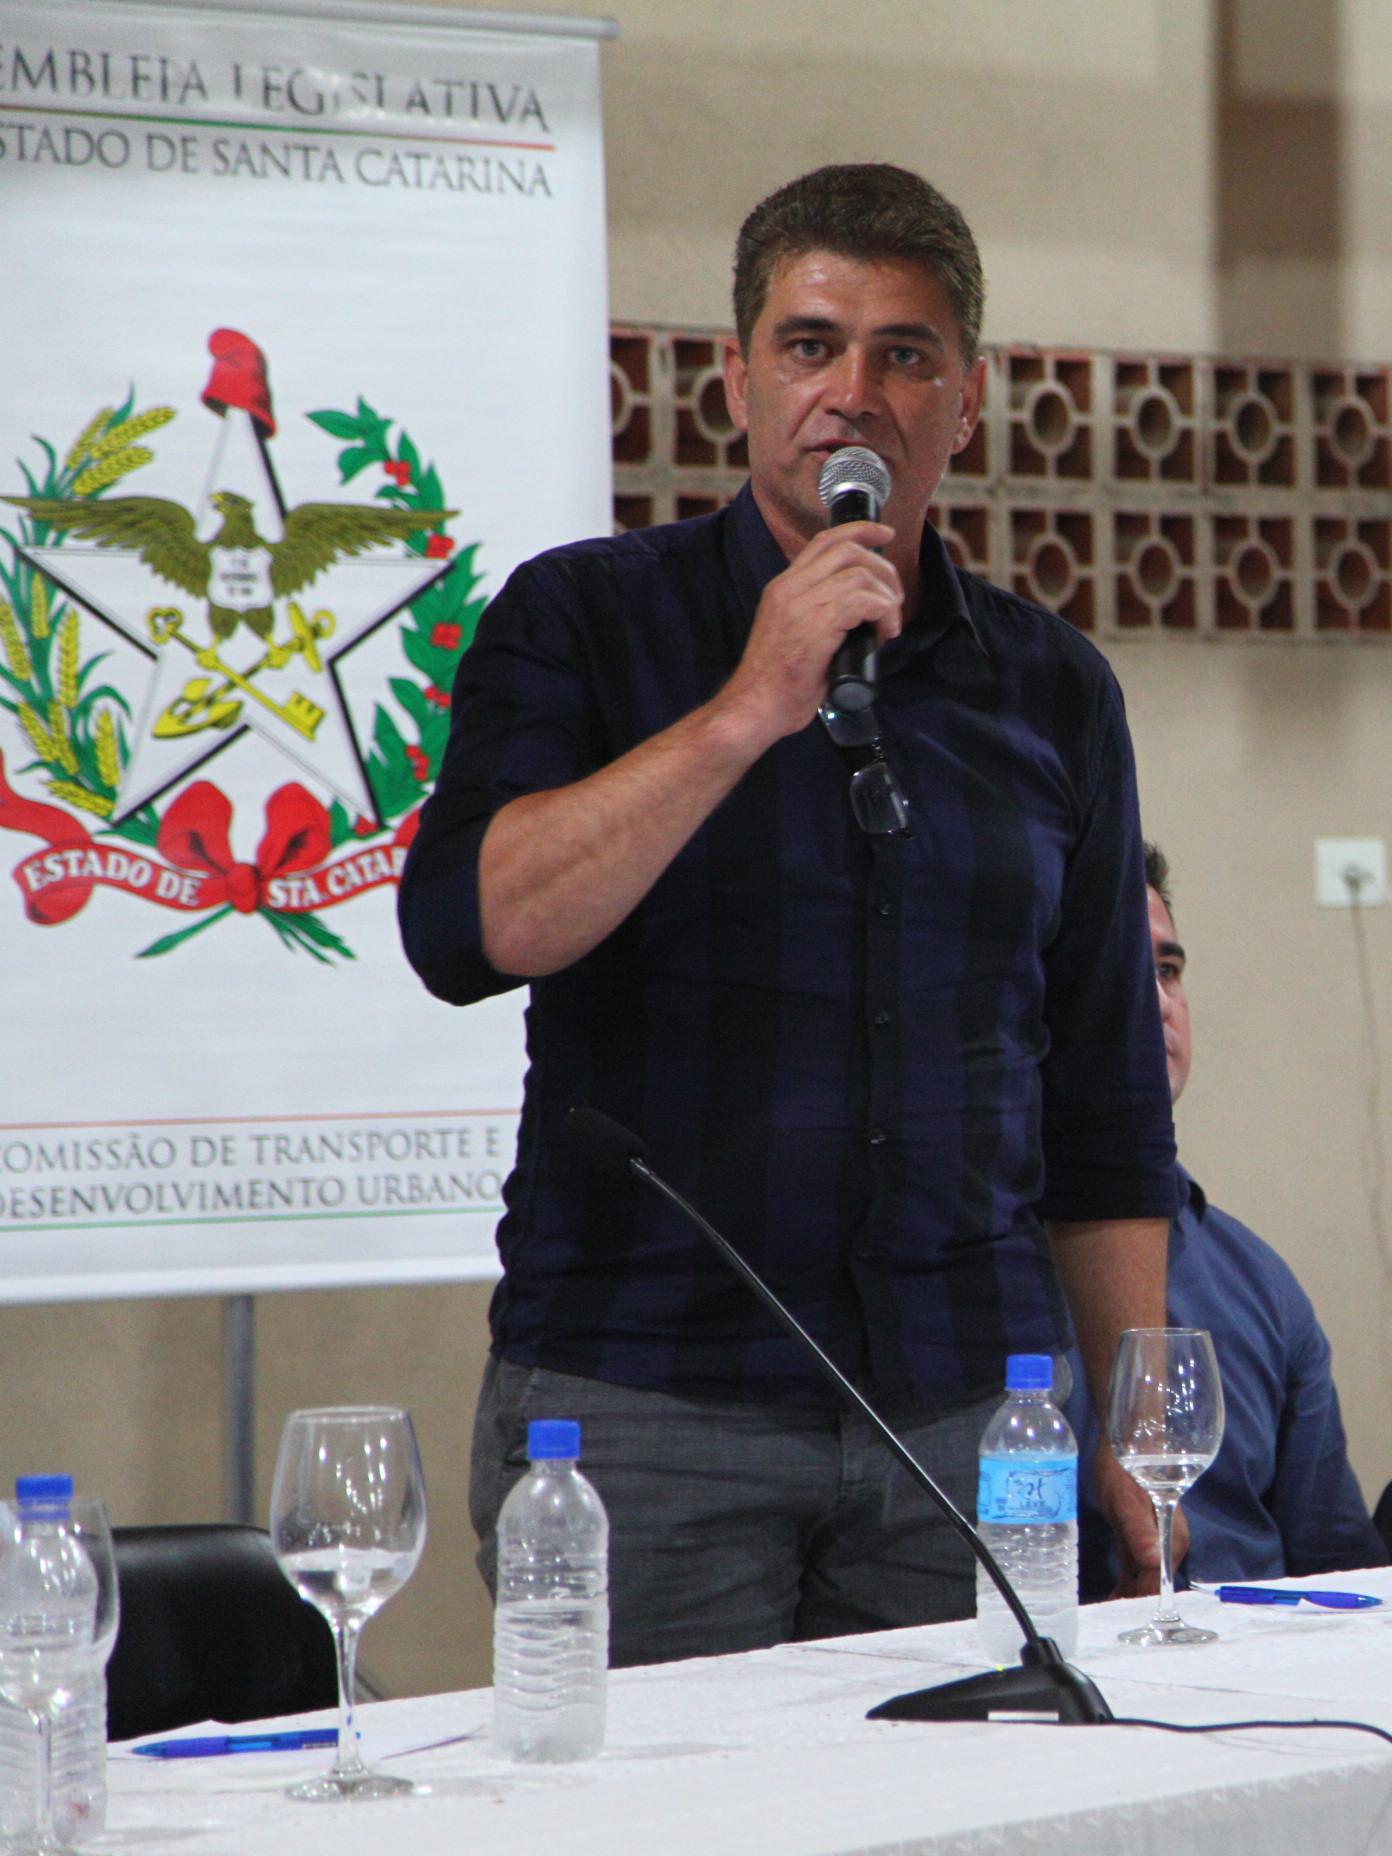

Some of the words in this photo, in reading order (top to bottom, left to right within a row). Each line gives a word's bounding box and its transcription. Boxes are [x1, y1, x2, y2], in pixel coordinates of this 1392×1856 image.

[0, 45, 209, 104] MBLEIA
[146, 132, 199, 174] DE
[211, 136, 346, 184] SANTA
[353, 147, 554, 198] CATARINA
[22, 848, 152, 892] ESTADO
[154, 869, 203, 907] DE
[0, 1133, 177, 1174] OMISSÃO
[190, 1134, 237, 1168] DE
[249, 1127, 472, 1166] TRANSPORTE
[485, 1126, 501, 1158] E
[357, 1169, 502, 1206] URBANO
